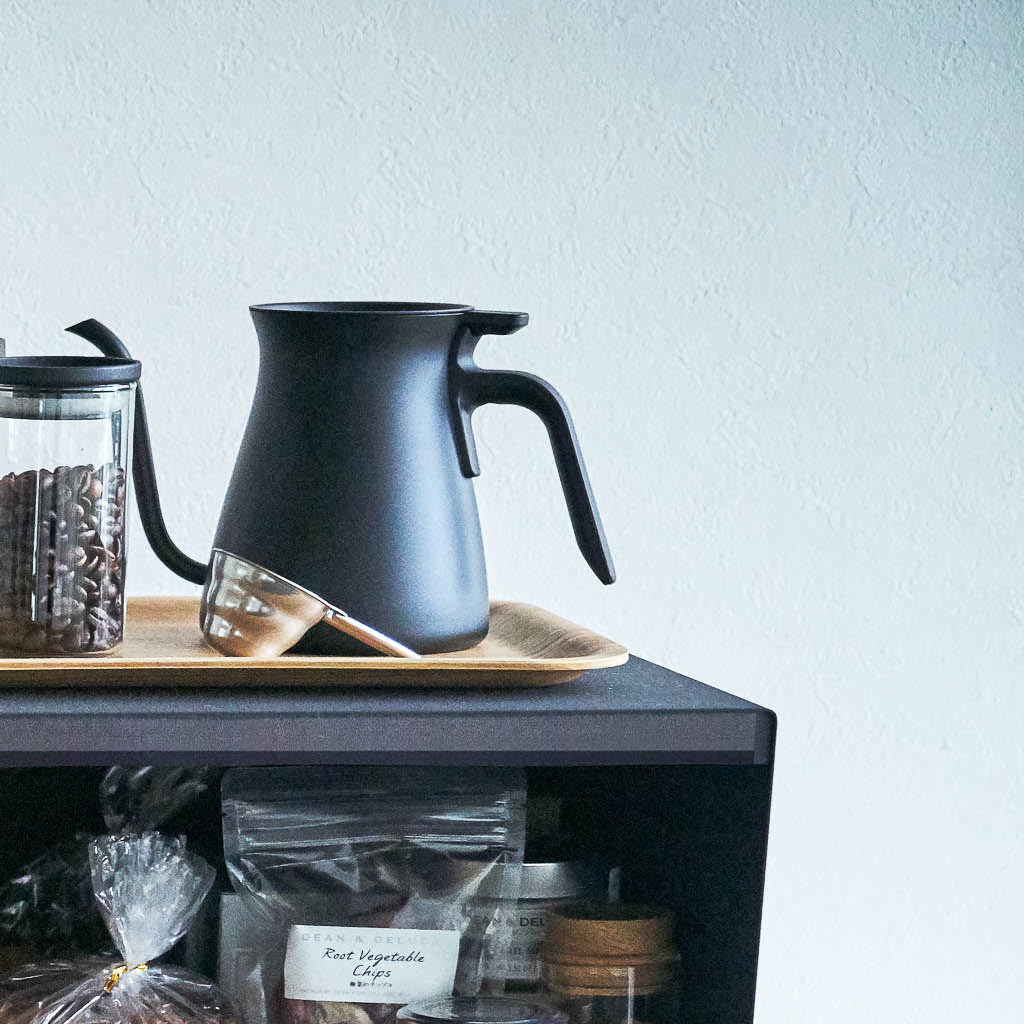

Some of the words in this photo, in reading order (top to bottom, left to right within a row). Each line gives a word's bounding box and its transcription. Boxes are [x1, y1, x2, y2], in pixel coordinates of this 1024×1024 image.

[301, 933, 345, 943] DEAN
[355, 934, 365, 943] &
[321, 947, 355, 961] Root
[359, 948, 425, 968] Vegetable
[352, 964, 392, 981] Chips
